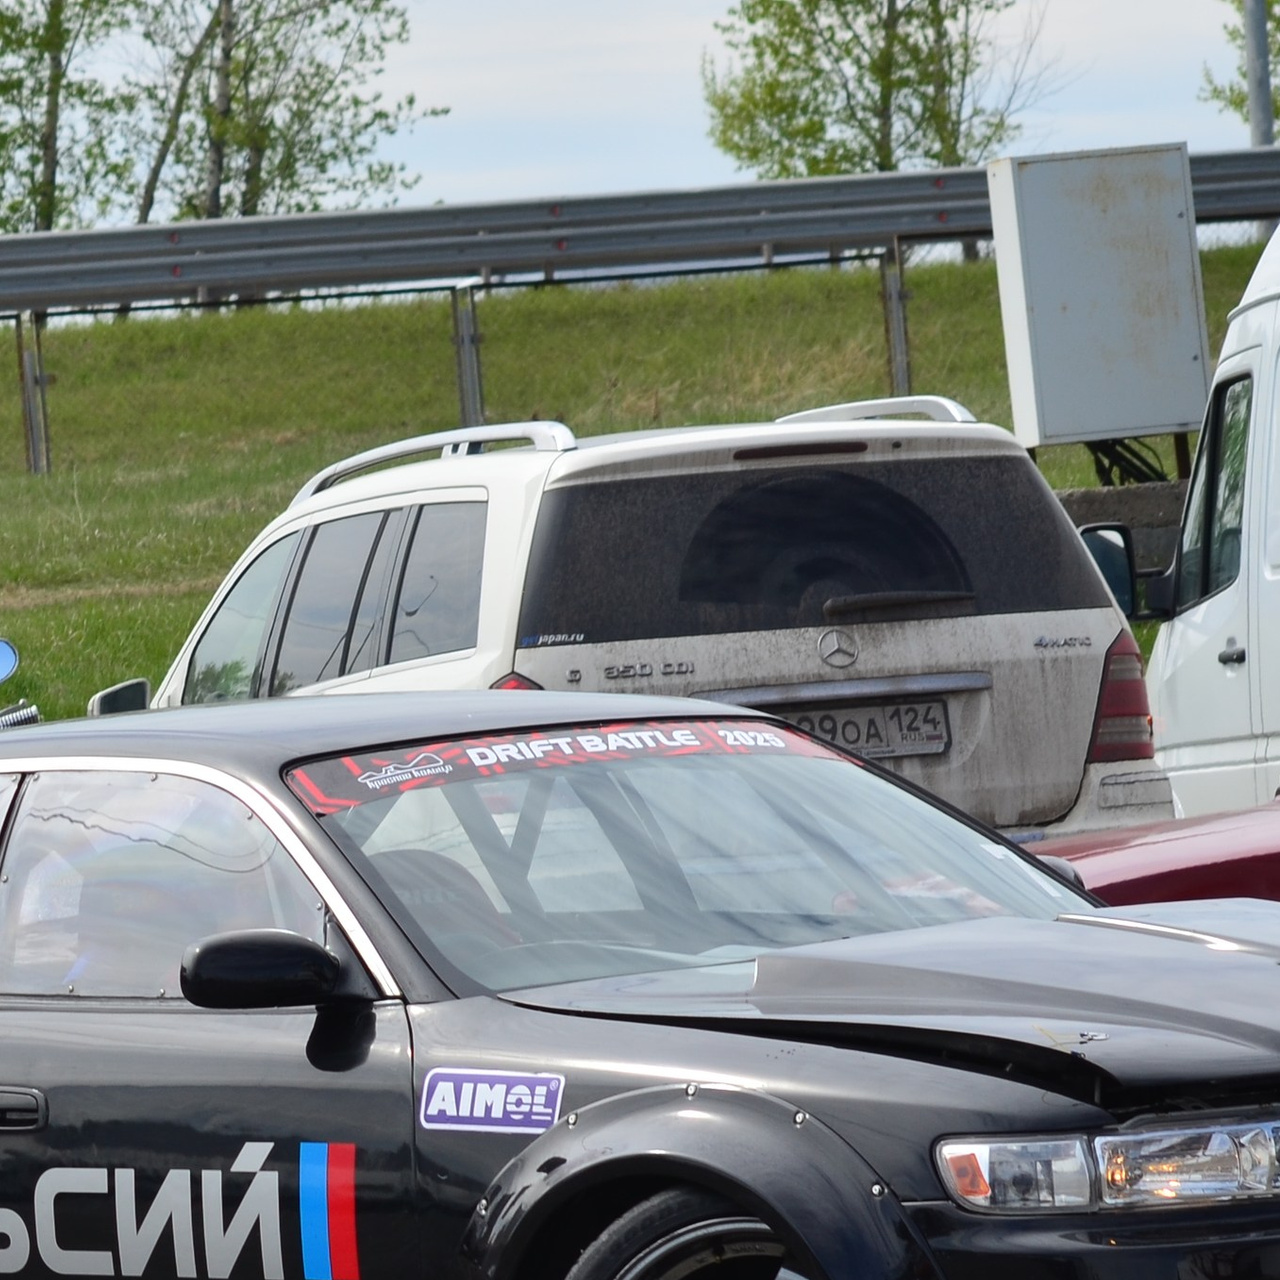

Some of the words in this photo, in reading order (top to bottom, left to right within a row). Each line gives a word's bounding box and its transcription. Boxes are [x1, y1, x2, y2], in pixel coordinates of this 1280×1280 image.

[890, 706, 938, 732] 124
[466, 738, 575, 767] DRIFT
[585, 730, 700, 752] BATTLE
[718, 728, 787, 749] 2025
[901, 731, 925, 742] RUS
[426, 1081, 553, 1121] AIMOL
